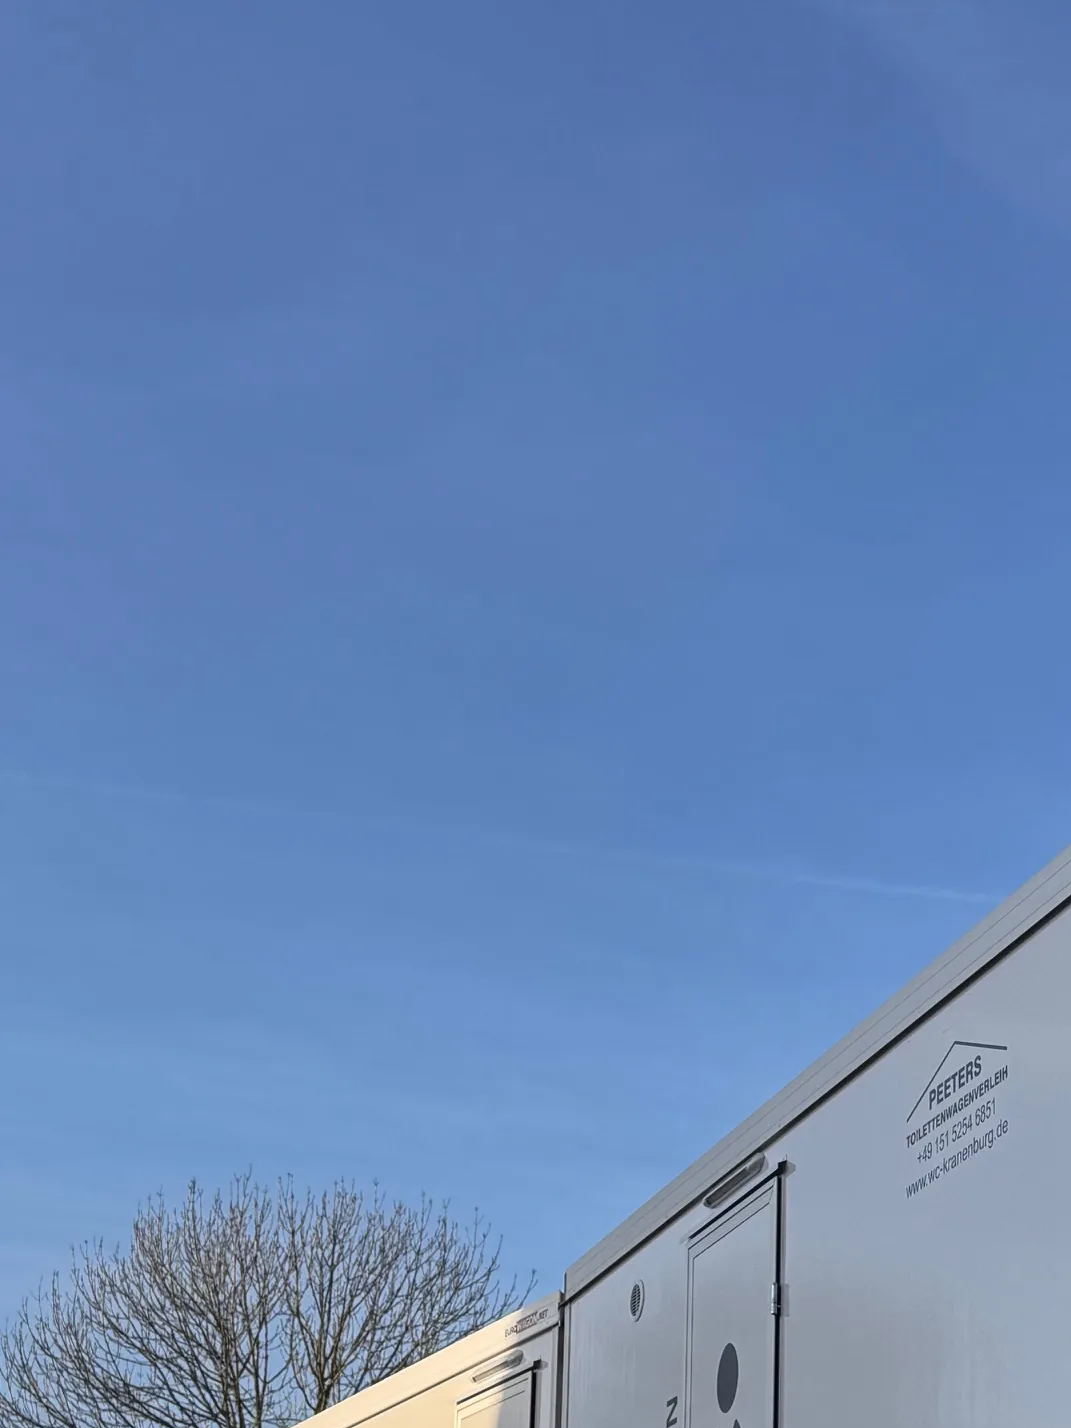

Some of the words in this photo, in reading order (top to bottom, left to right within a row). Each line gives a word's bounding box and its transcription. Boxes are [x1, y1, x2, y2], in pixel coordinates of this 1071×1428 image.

[905, 1065, 1008, 1149] TOILETTENWAGENVERLEIH
[928, 1054, 982, 1110] PEETERS
[905, 1118, 1009, 1199] www.wc-kranenburg.de
[916, 1142, 933, 1164] +49
[934, 1130, 949, 1154] 151
[951, 1114, 973, 1143] 5254
[974, 1097, 996, 1126] 6851
